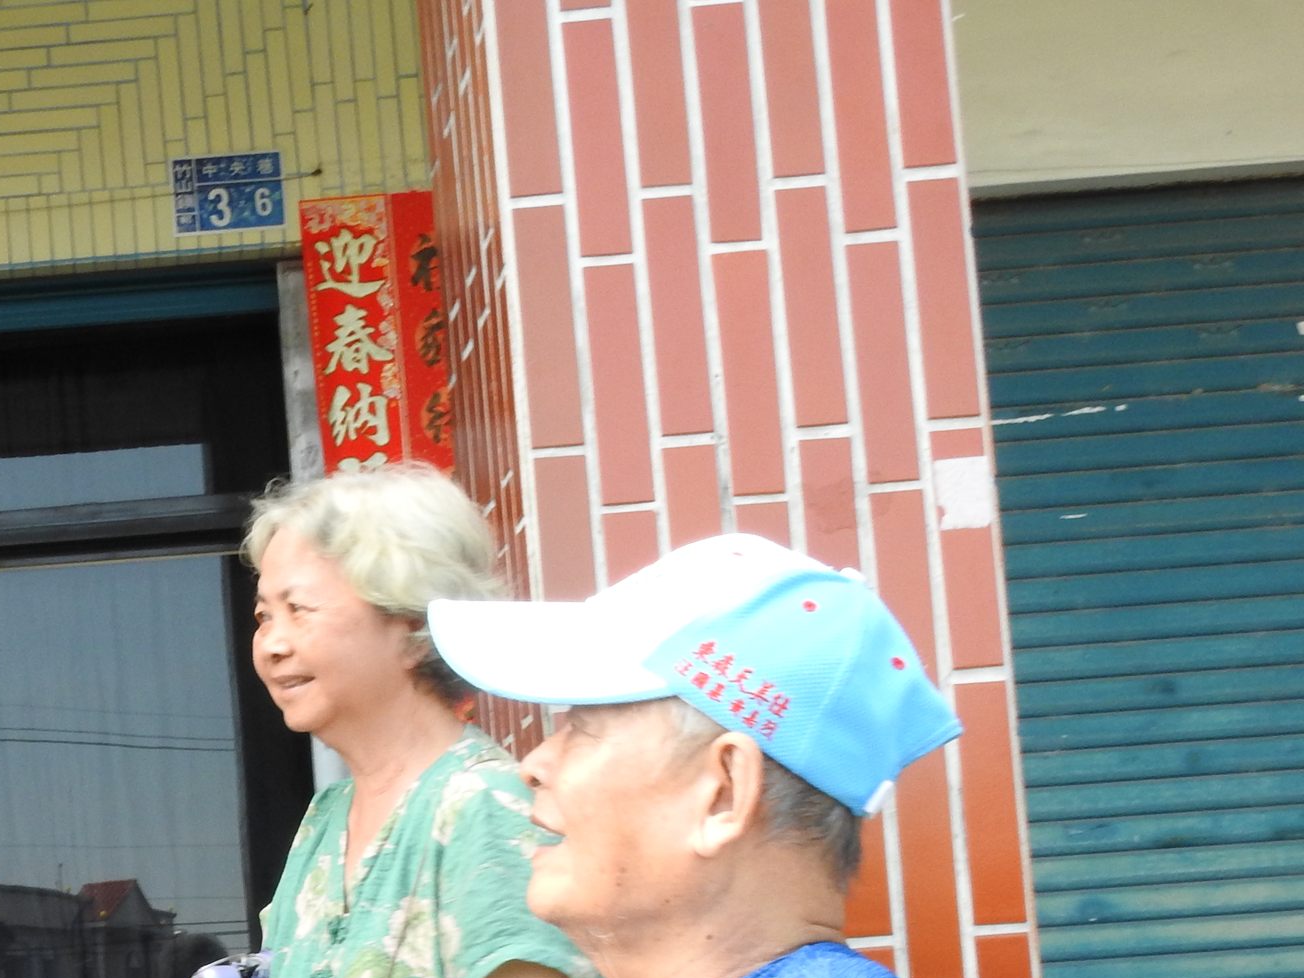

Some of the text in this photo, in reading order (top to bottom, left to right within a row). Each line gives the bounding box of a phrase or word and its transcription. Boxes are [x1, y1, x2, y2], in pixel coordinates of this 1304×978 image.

[202, 158, 274, 178] 中央巷
[207, 187, 273, 227] 36
[314, 228, 394, 474] 迎春納
